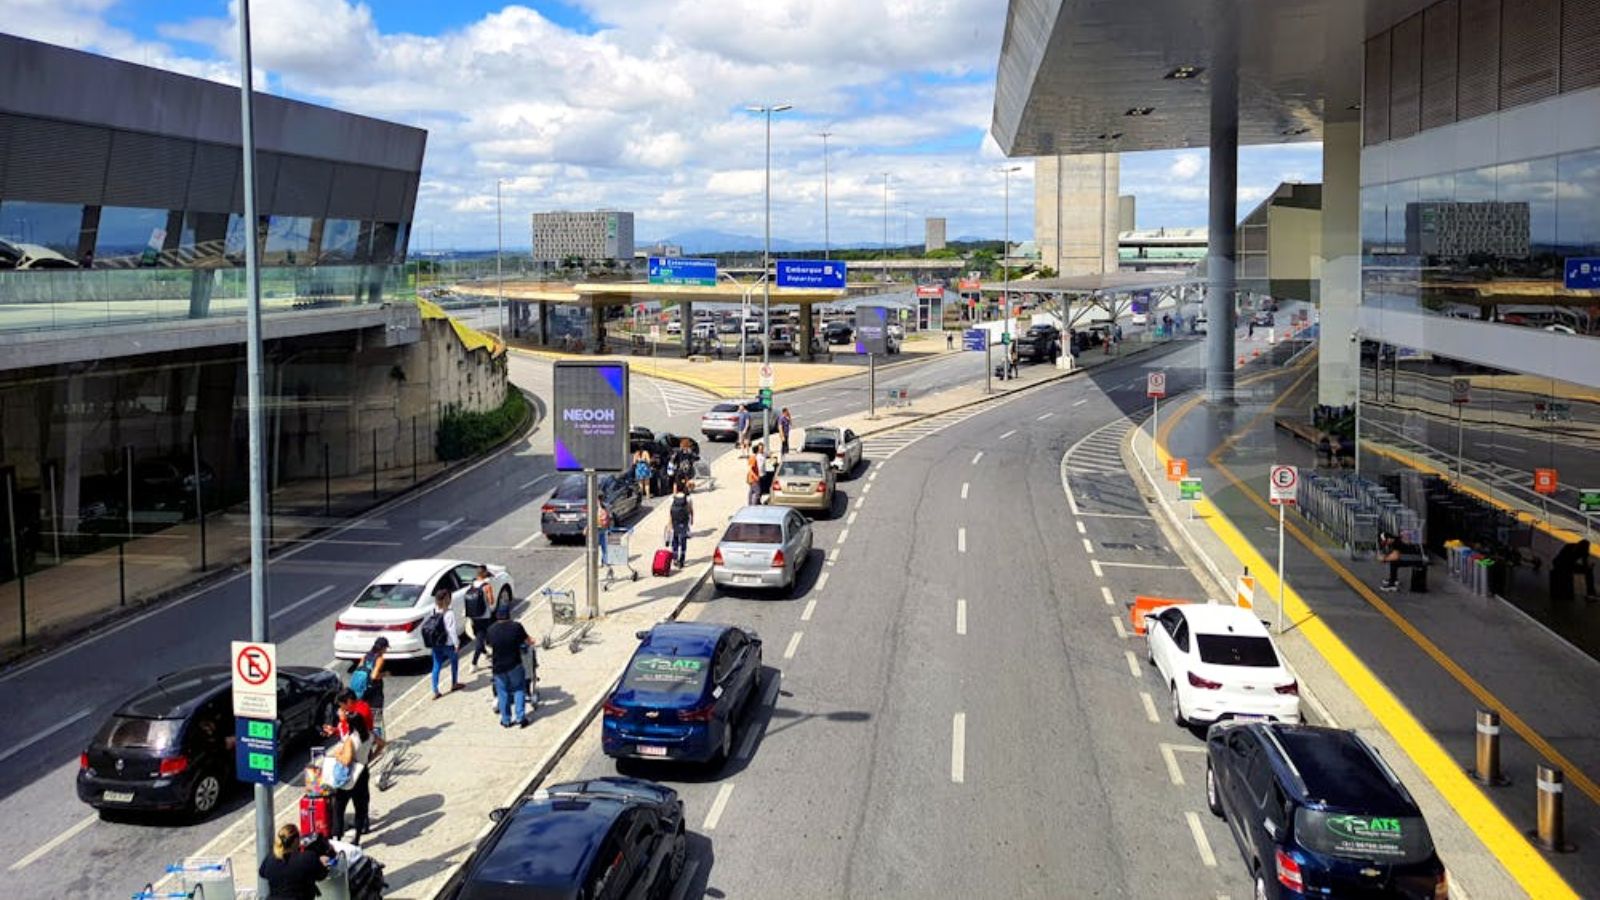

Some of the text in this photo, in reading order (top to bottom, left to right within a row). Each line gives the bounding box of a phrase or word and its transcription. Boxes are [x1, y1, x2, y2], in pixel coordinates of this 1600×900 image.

[785, 266, 822, 274] Embarque
[563, 408, 615, 421] NEOOH
[1279, 471, 1288, 484] E
[672, 659, 700, 670] ATS
[1371, 817, 1401, 832] ATS
